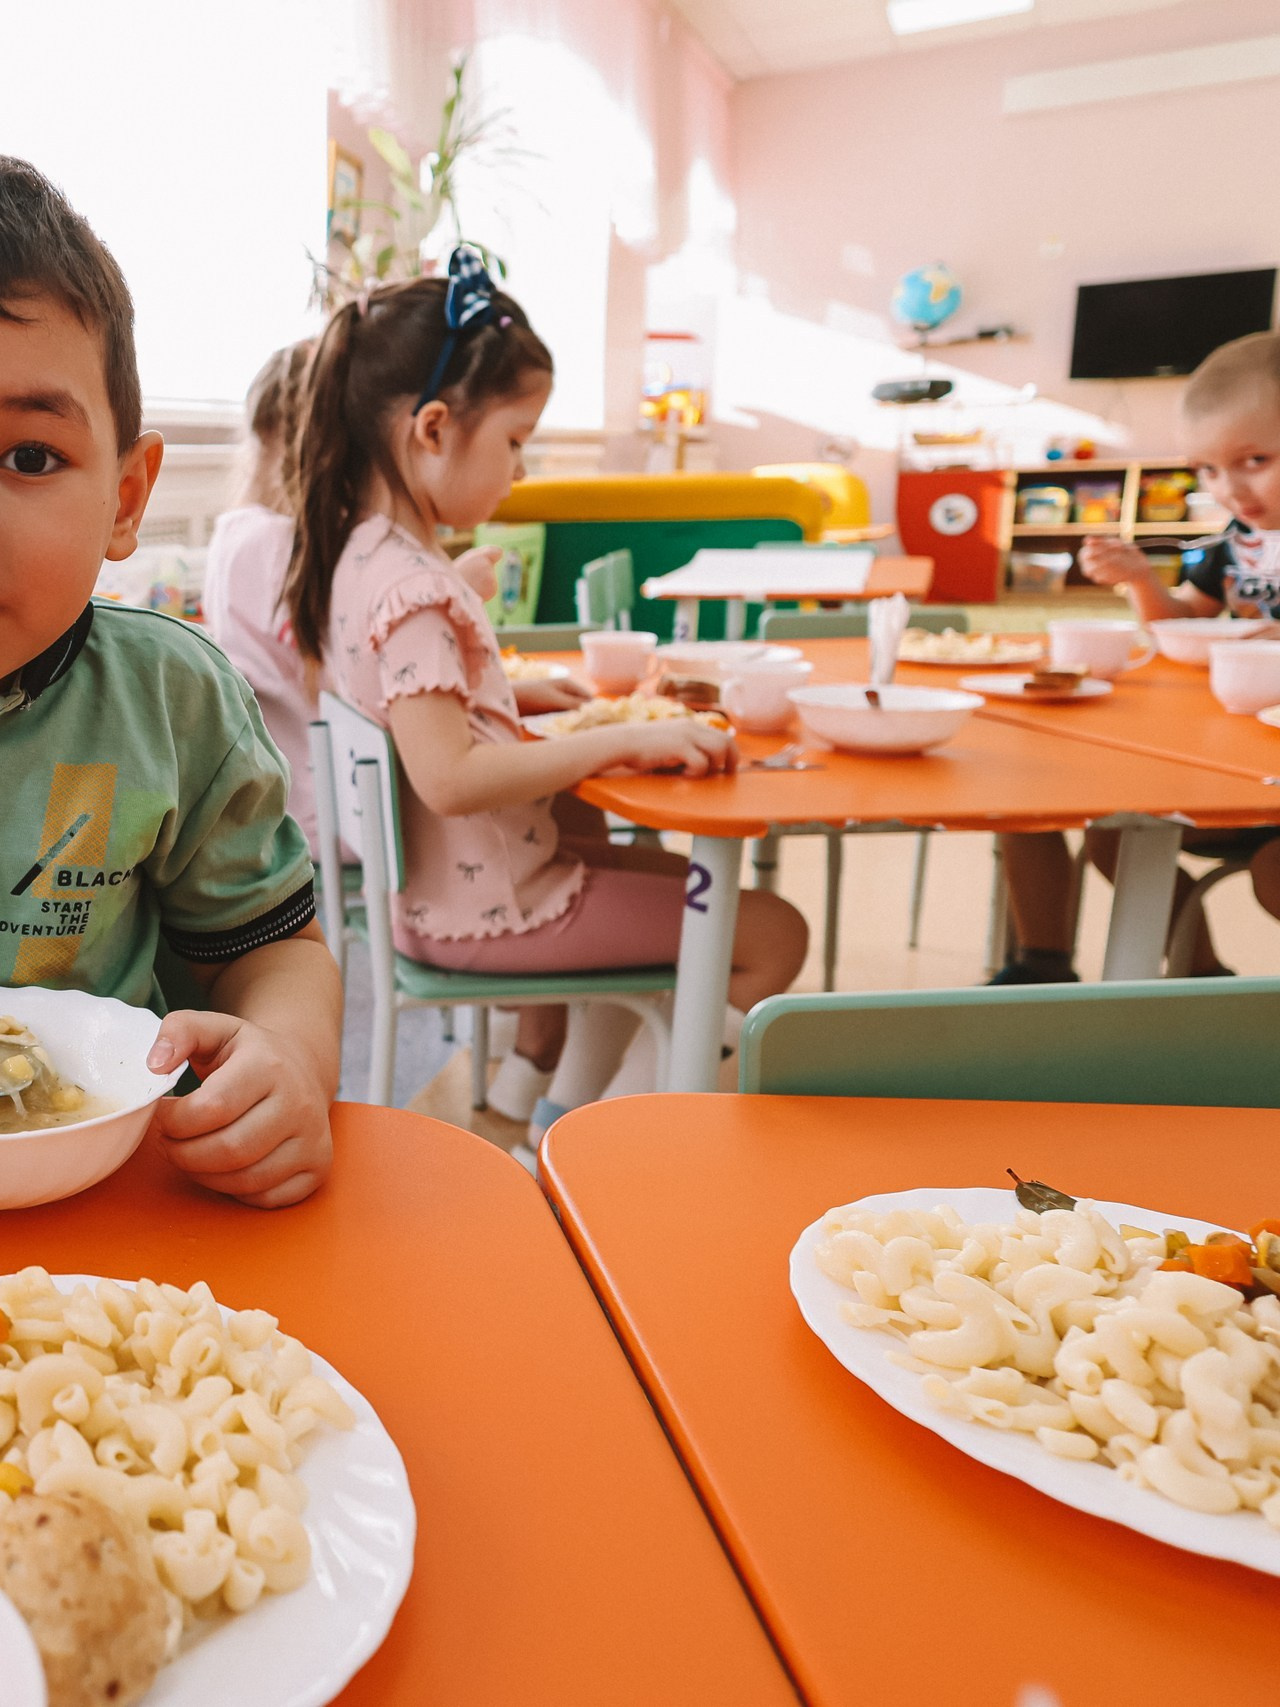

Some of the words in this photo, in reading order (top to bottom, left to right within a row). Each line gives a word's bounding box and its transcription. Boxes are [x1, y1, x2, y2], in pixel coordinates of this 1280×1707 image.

[686, 863, 712, 913] 2
[41, 900, 91, 913] START
[60, 913, 89, 924] THE
